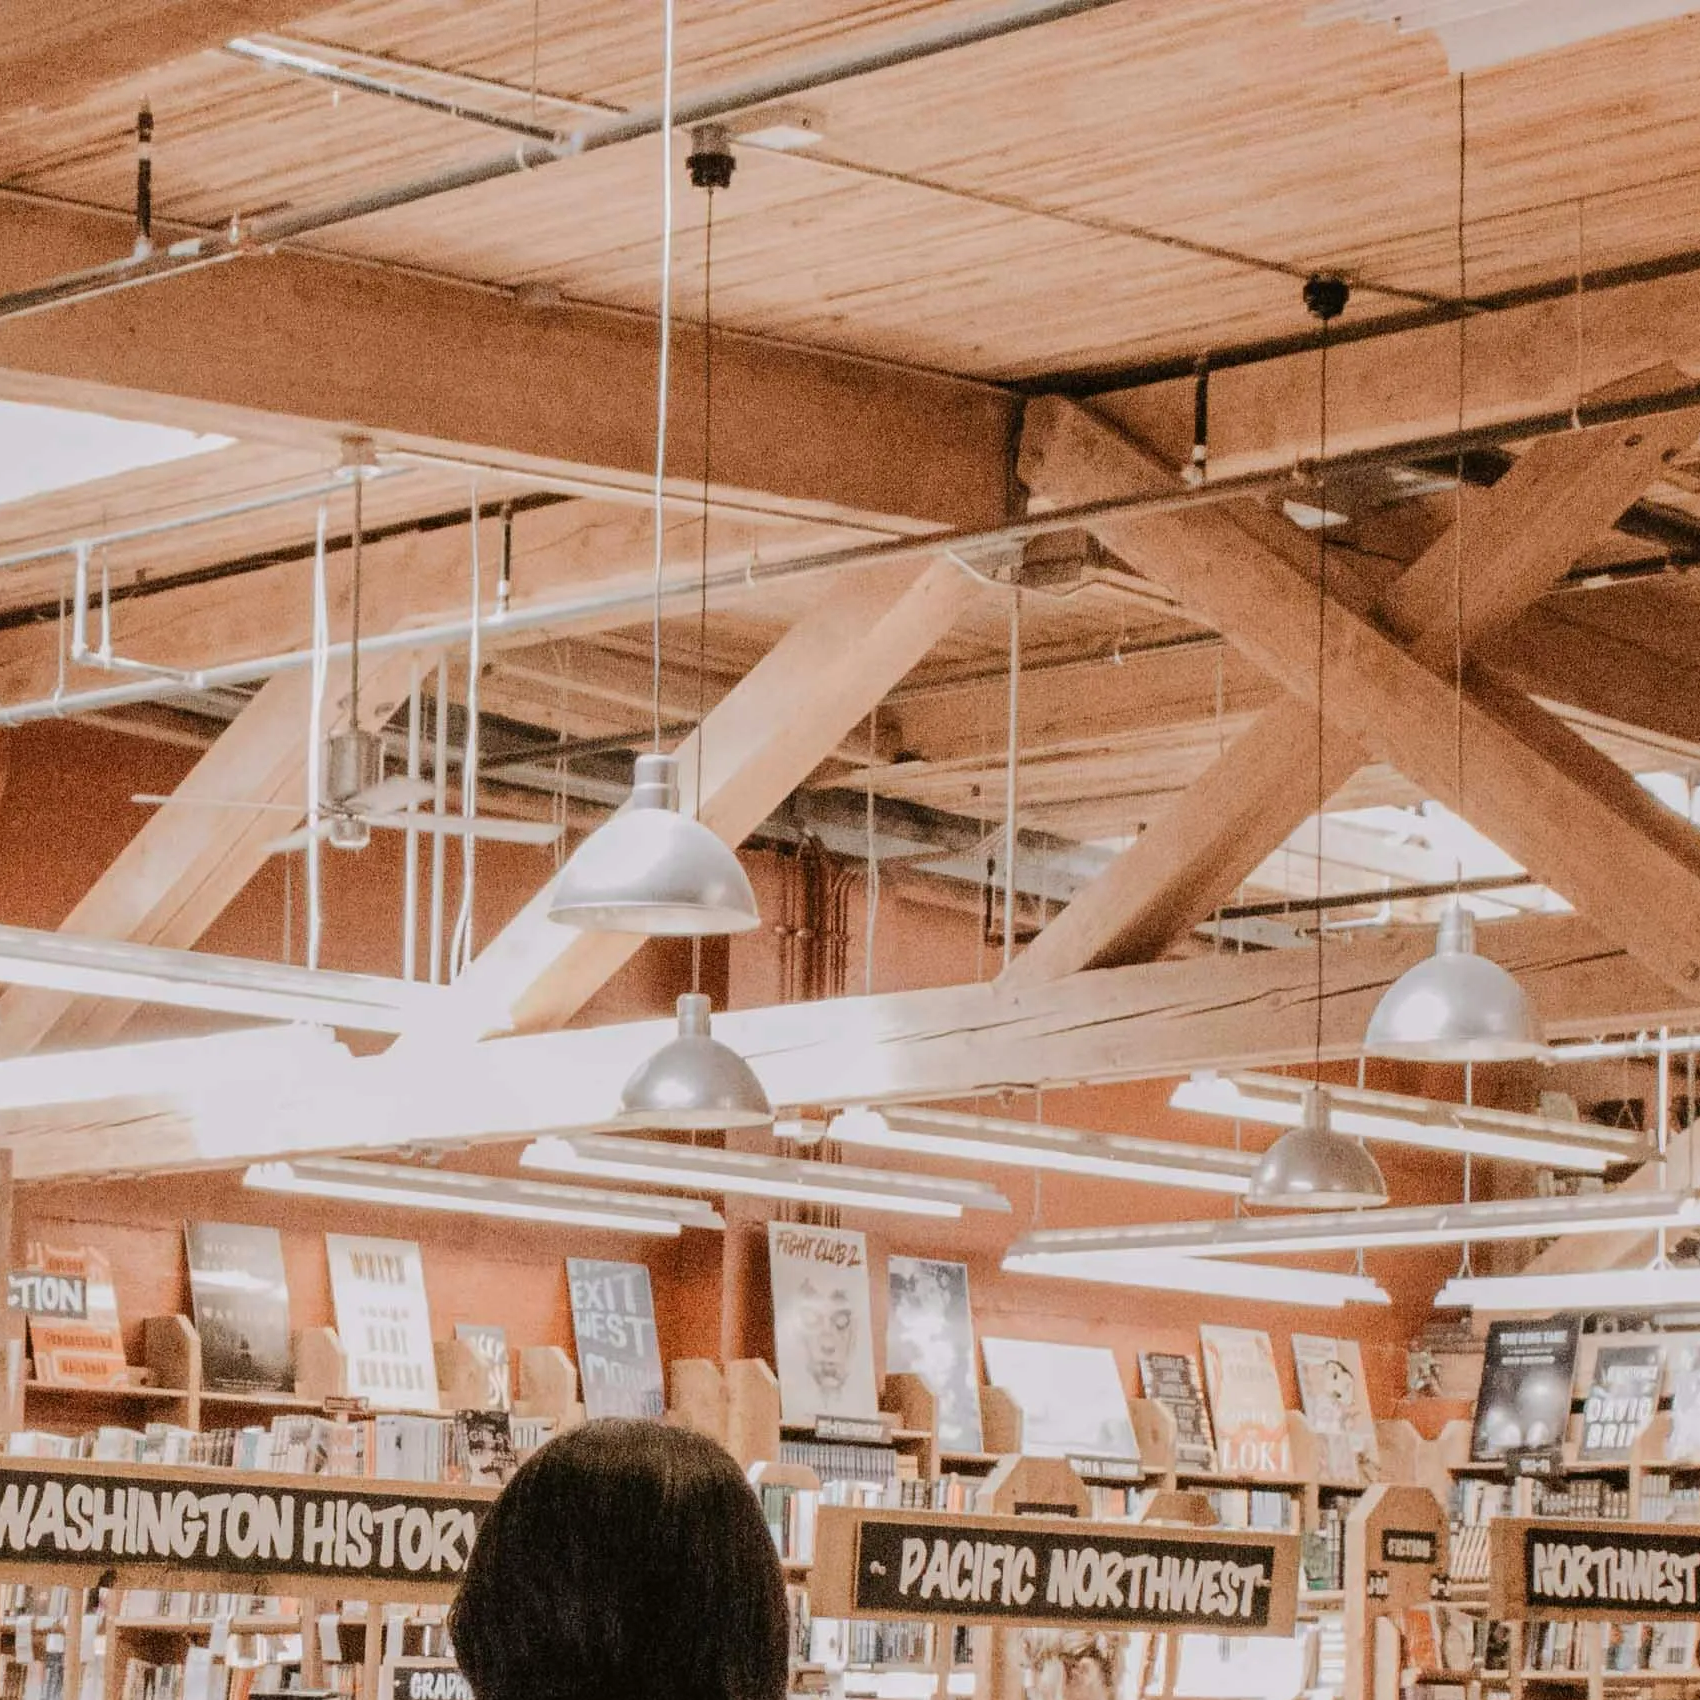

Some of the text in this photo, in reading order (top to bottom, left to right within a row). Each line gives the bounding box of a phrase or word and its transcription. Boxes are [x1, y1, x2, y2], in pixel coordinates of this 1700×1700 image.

[573, 1273, 639, 1313] EXIT
[578, 1313, 653, 1357] WEST
[1585, 1397, 1653, 1421] DAVID
[1222, 1441, 1290, 1472] LOKI
[303, 1500, 479, 1582] HISTORY
[1386, 1538, 1431, 1558] FICTION
[899, 1537, 1263, 1616] PACIFIC NORTHWEST
[1531, 1542, 1700, 1604] NORTHWEST
